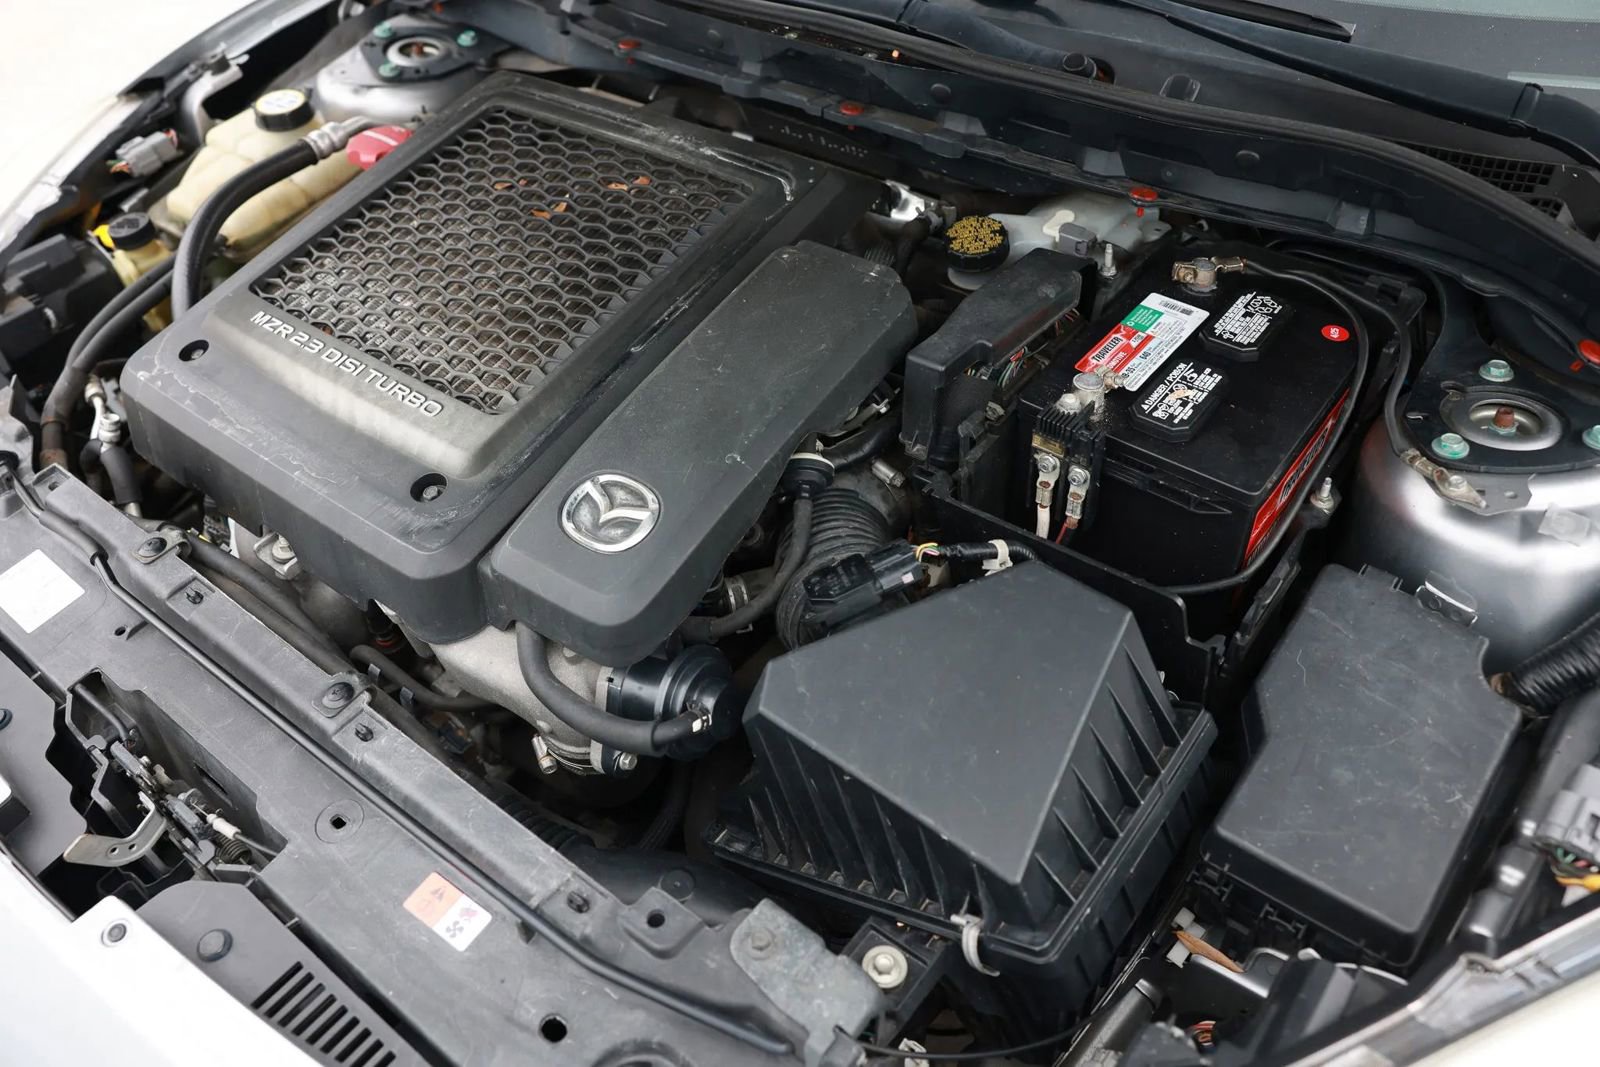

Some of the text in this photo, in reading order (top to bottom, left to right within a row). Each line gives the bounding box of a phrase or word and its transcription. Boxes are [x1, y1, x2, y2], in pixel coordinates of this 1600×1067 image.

[250, 310, 444, 417] MZR 2.3 DISI TURBO
[1091, 336, 1123, 362] TRAVELLER
[1144, 384, 1168, 405] DANGER
[1166, 362, 1187, 381] POISON
